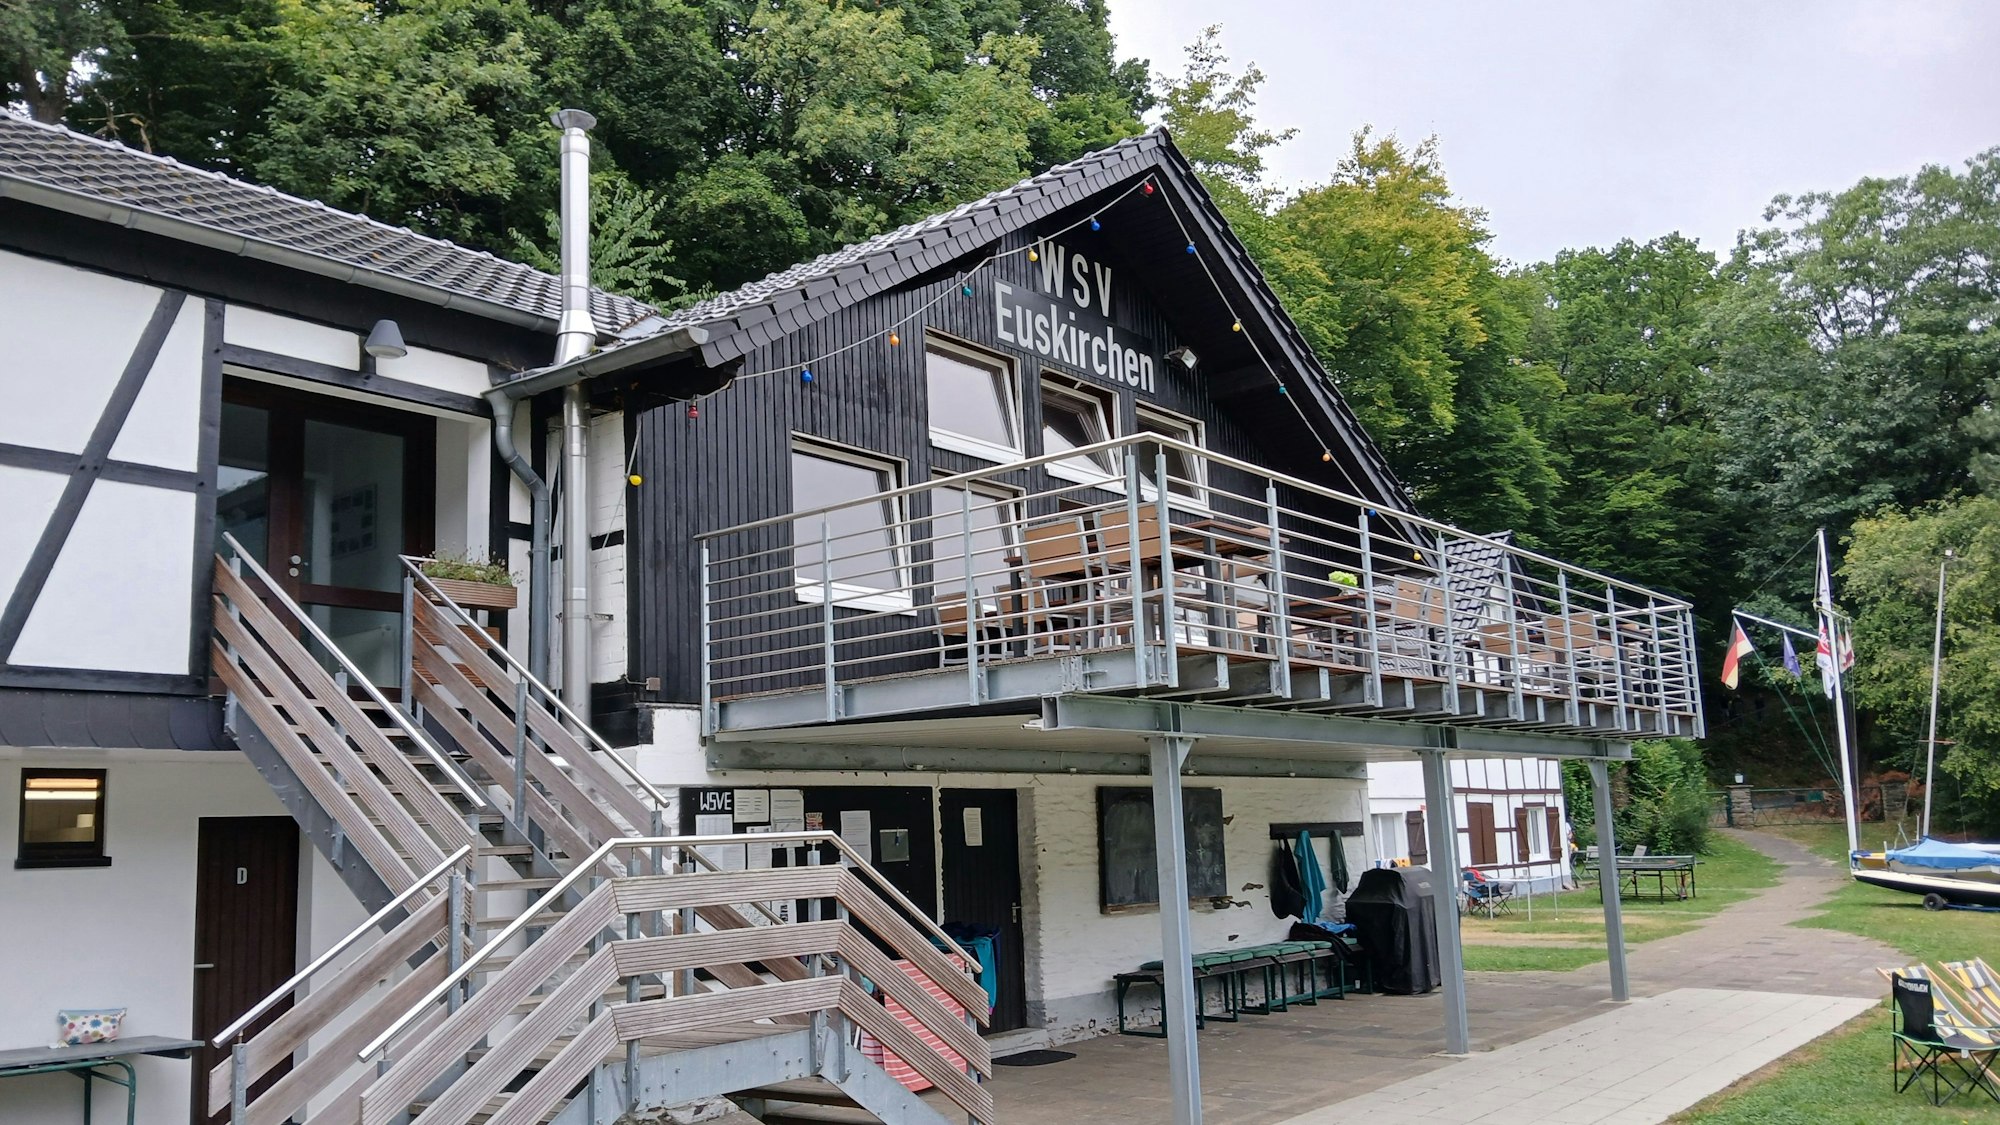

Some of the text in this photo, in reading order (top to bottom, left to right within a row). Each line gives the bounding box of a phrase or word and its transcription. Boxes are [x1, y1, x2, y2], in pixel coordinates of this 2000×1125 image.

[1038, 237, 1112, 317] WSV
[995, 282, 1155, 393] Euskirchen
[700, 792, 732, 811] WSVE
[237, 867, 248, 884] D
